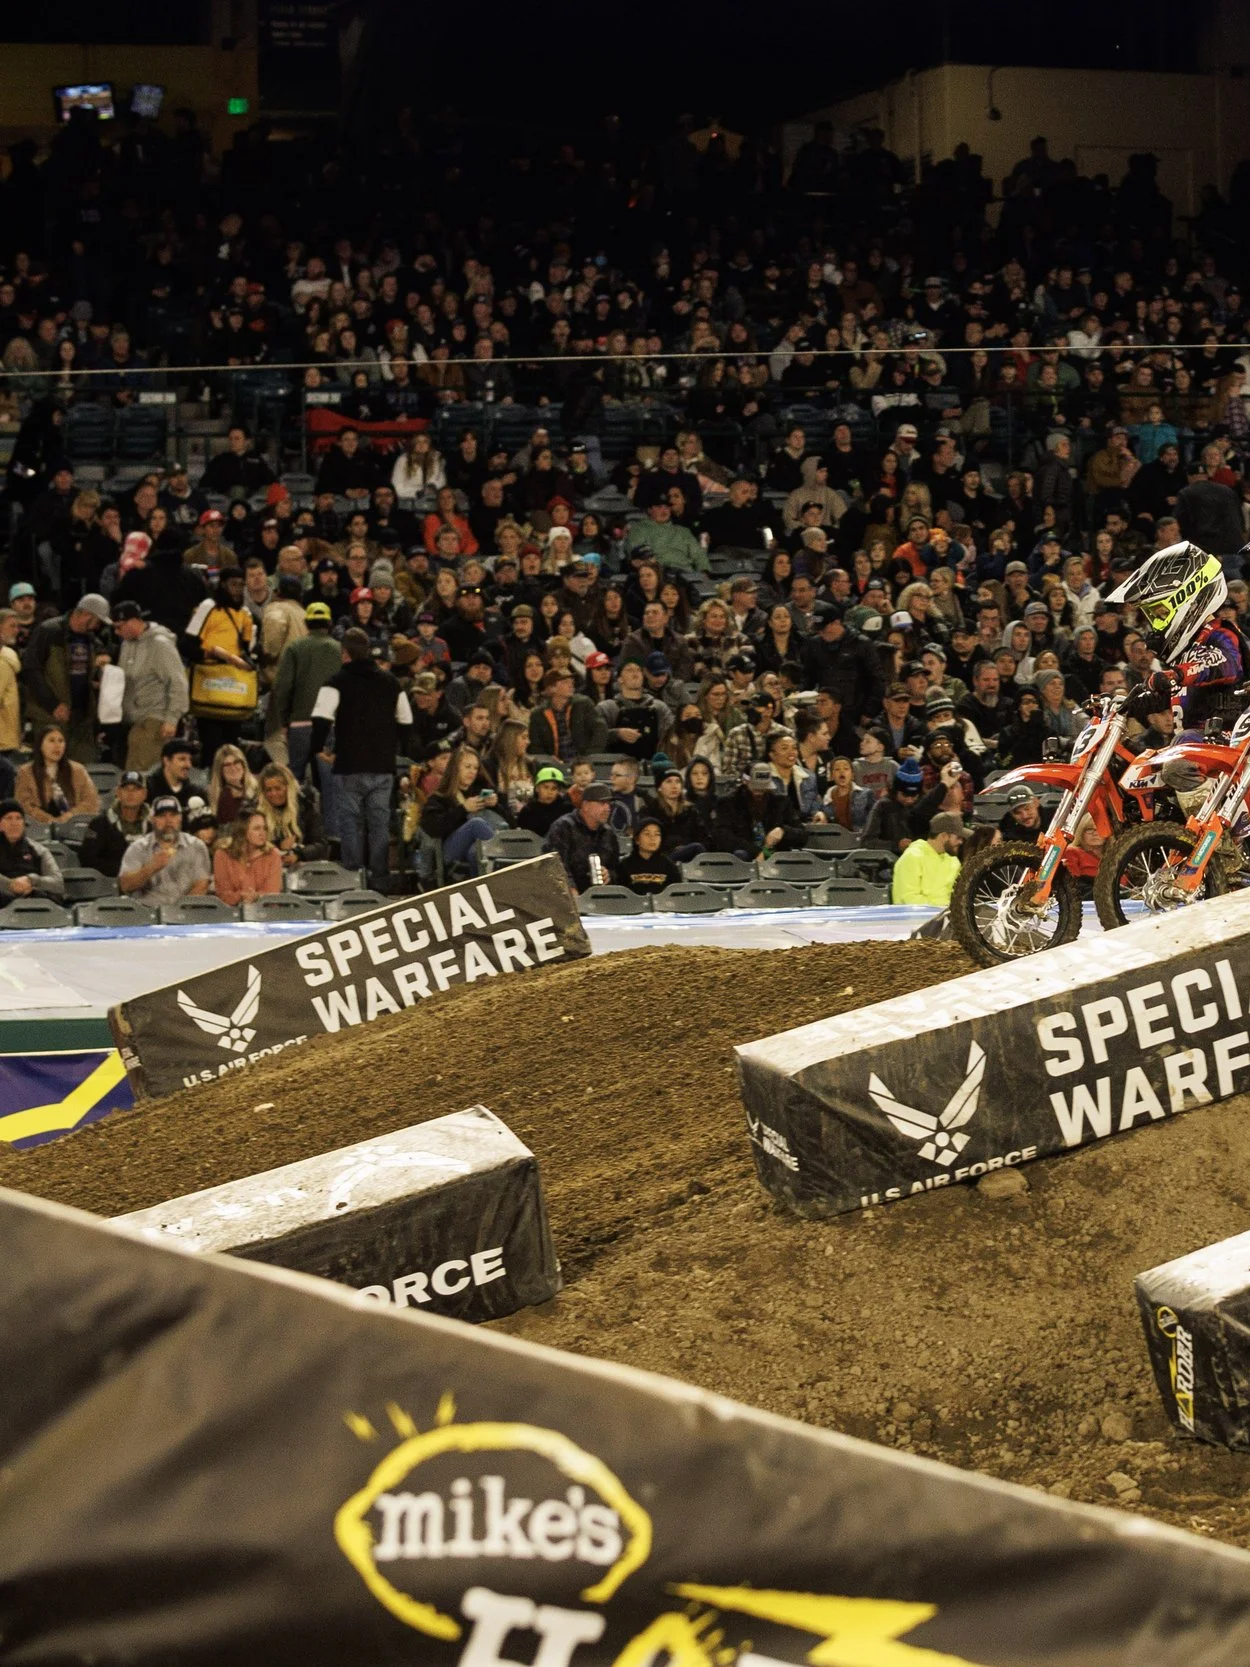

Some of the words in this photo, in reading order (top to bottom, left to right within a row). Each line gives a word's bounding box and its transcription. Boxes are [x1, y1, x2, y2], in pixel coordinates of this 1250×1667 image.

[1168, 571, 1209, 609] 100%
[1129, 779, 1149, 789] KTM
[296, 885, 515, 987] SPECIAL
[311, 917, 565, 1034] WARFARE
[182, 1069, 217, 1088] U.S.
[218, 1057, 246, 1077] AIR
[910, 1173, 950, 1195] AIR
[954, 1145, 1038, 1183] FORCE
[373, 1474, 625, 1565] mike's
